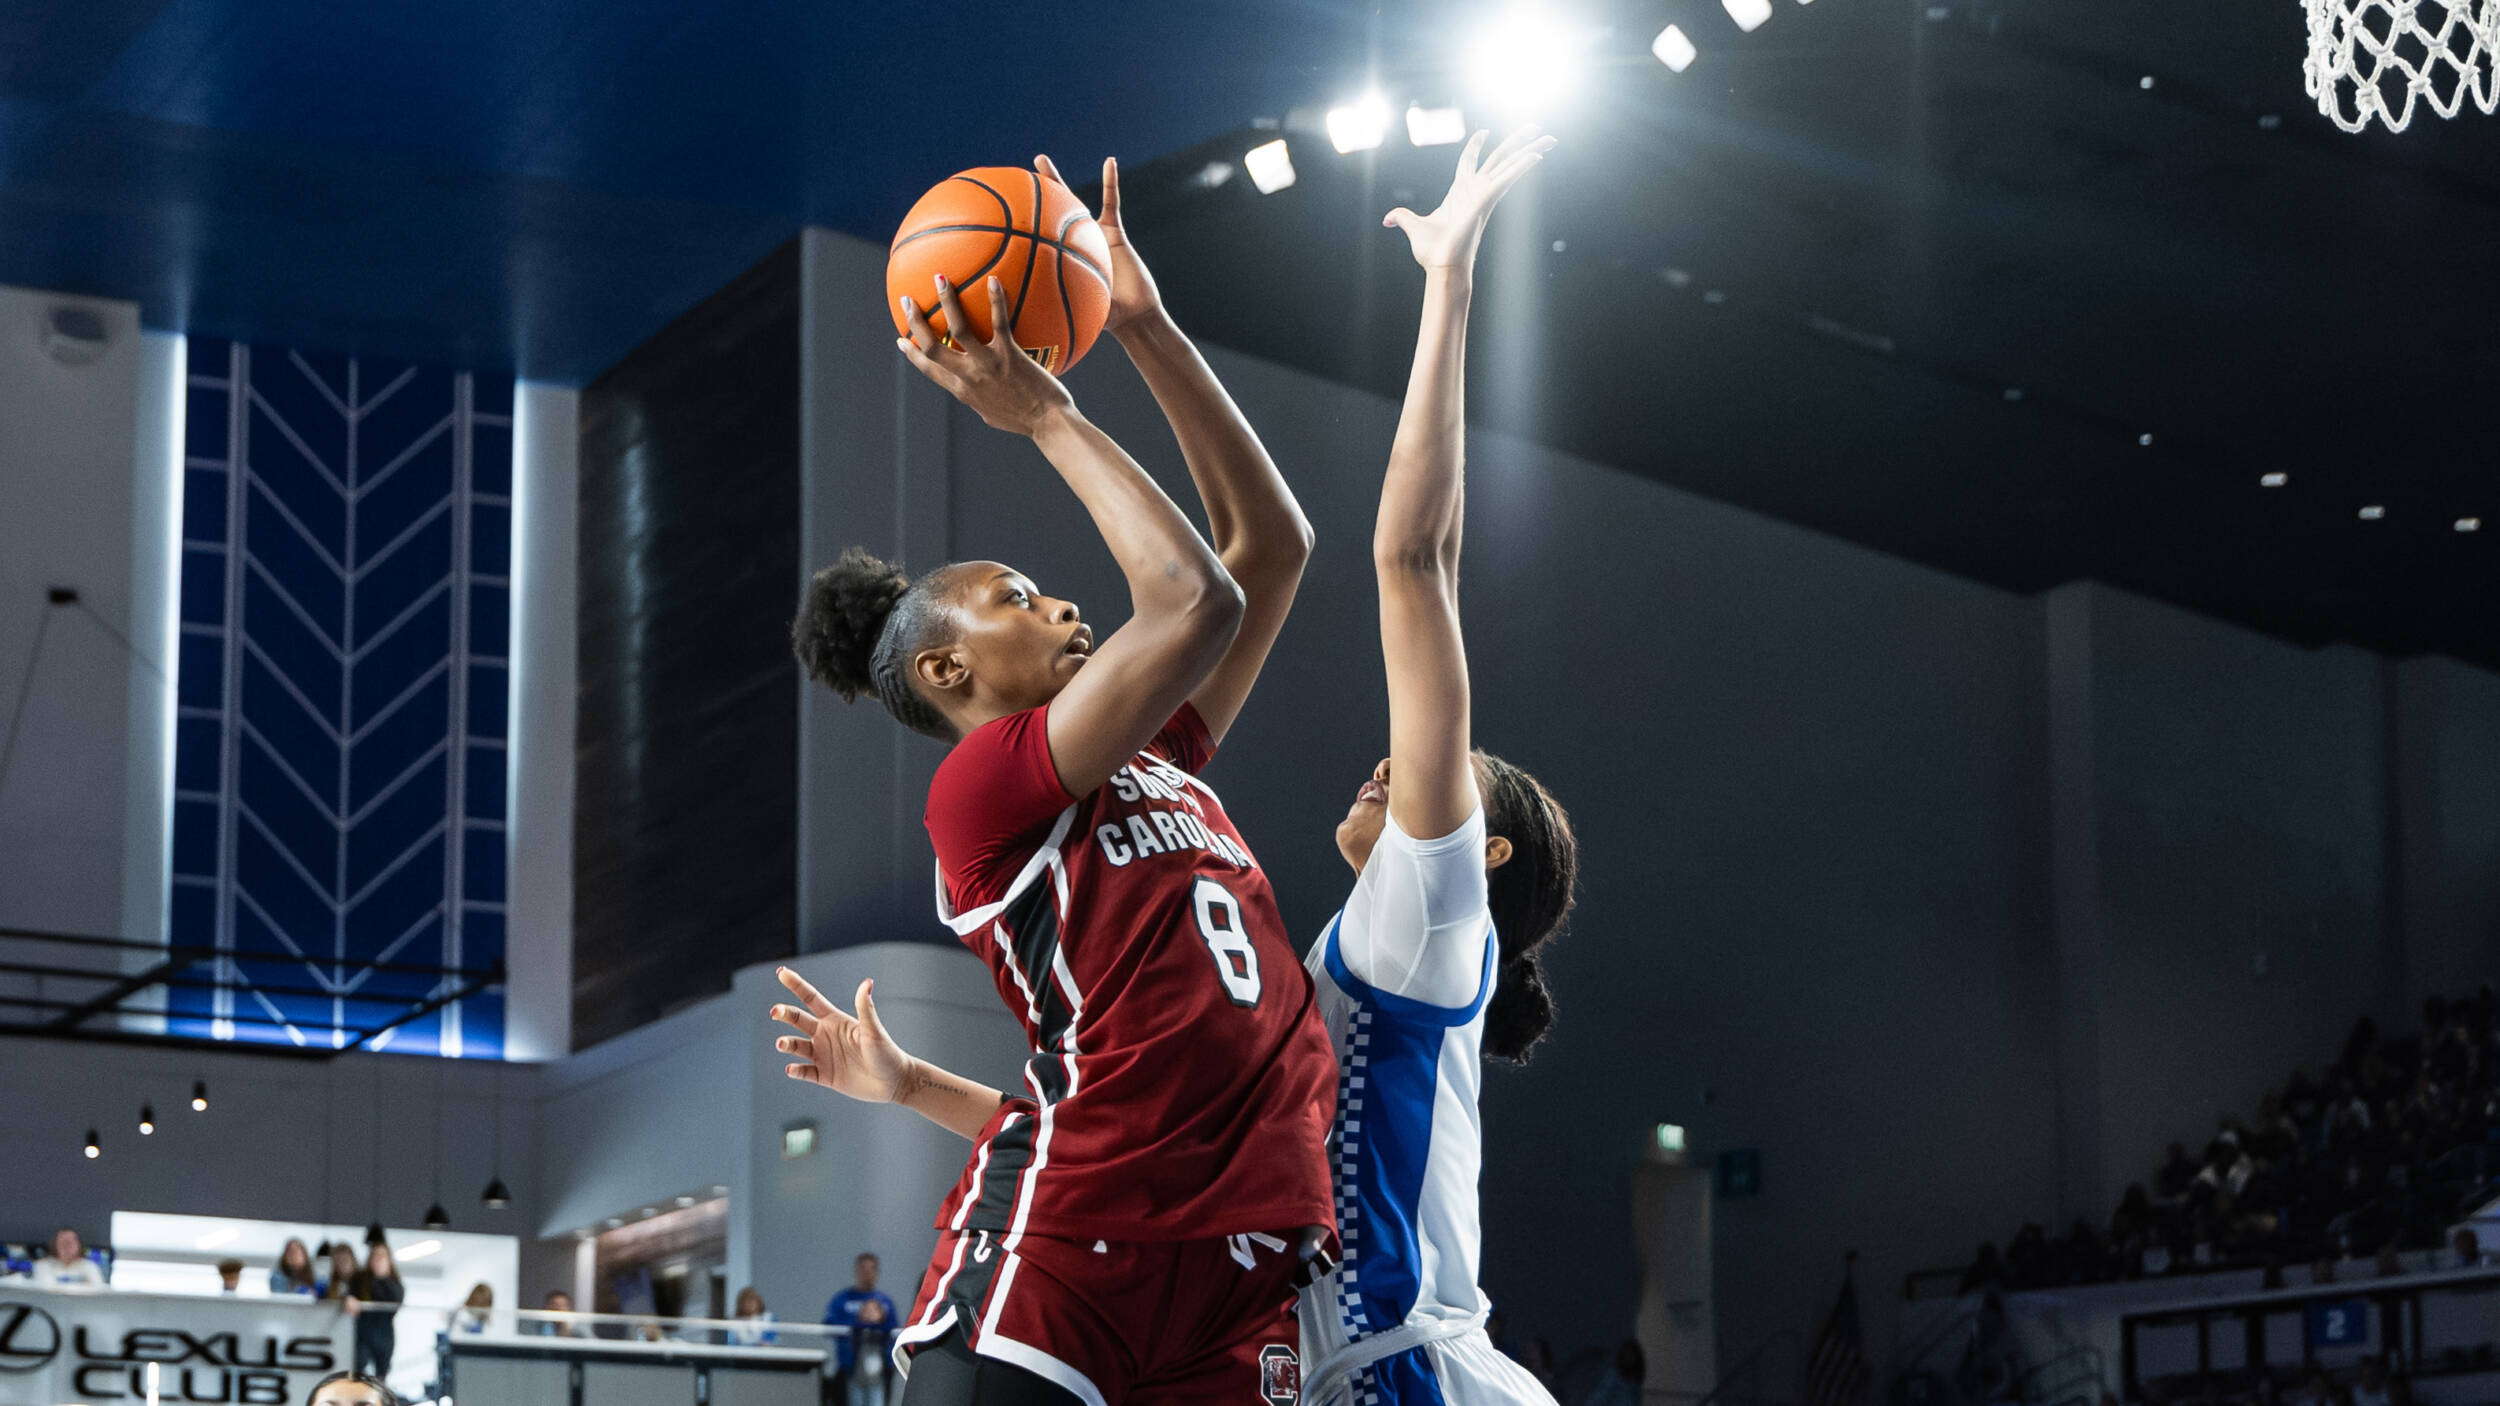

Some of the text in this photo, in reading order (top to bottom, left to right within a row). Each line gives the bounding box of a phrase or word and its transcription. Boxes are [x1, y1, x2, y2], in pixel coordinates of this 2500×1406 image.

[1109, 765, 1204, 818] SOU
[1191, 874, 1262, 1009] 8
[2325, 1308, 2346, 1340] 2
[73, 1325, 335, 1370] LEXUS
[74, 1362, 289, 1405] CLUB
